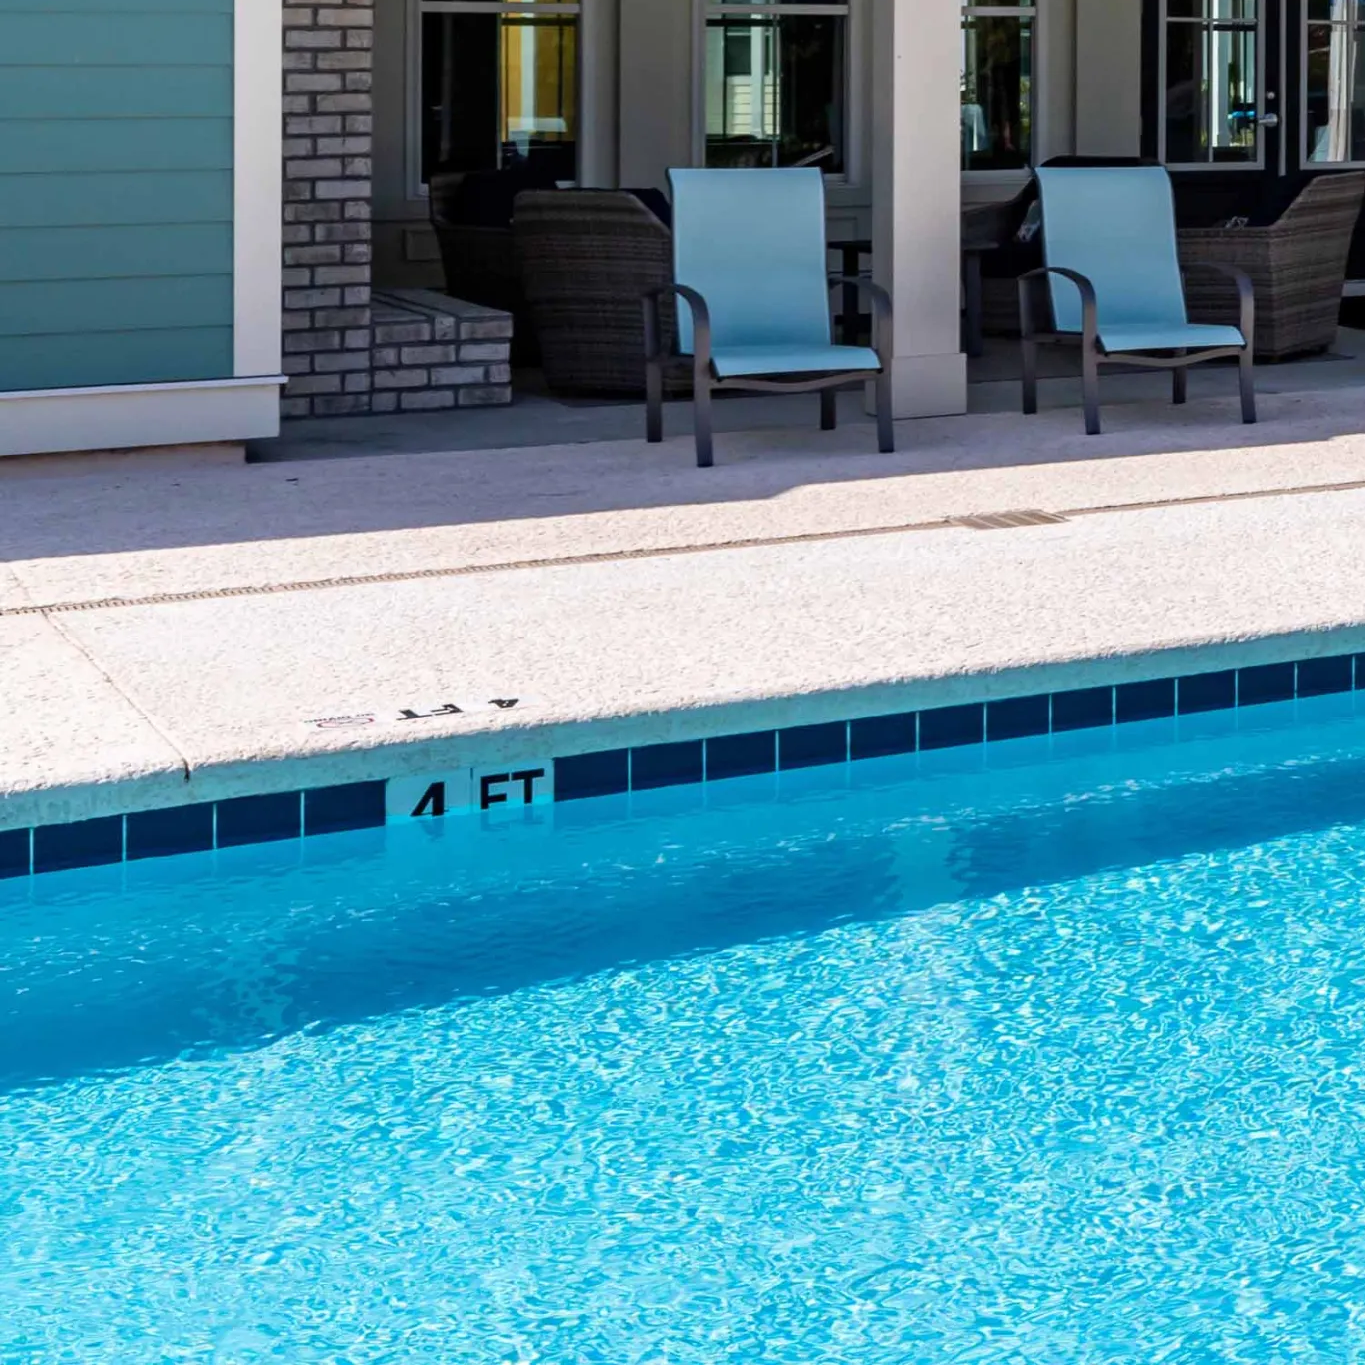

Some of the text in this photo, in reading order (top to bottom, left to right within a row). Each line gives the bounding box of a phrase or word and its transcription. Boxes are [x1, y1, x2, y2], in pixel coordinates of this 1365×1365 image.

[396, 703, 464, 720] FT
[410, 768, 545, 817] 4 FT
